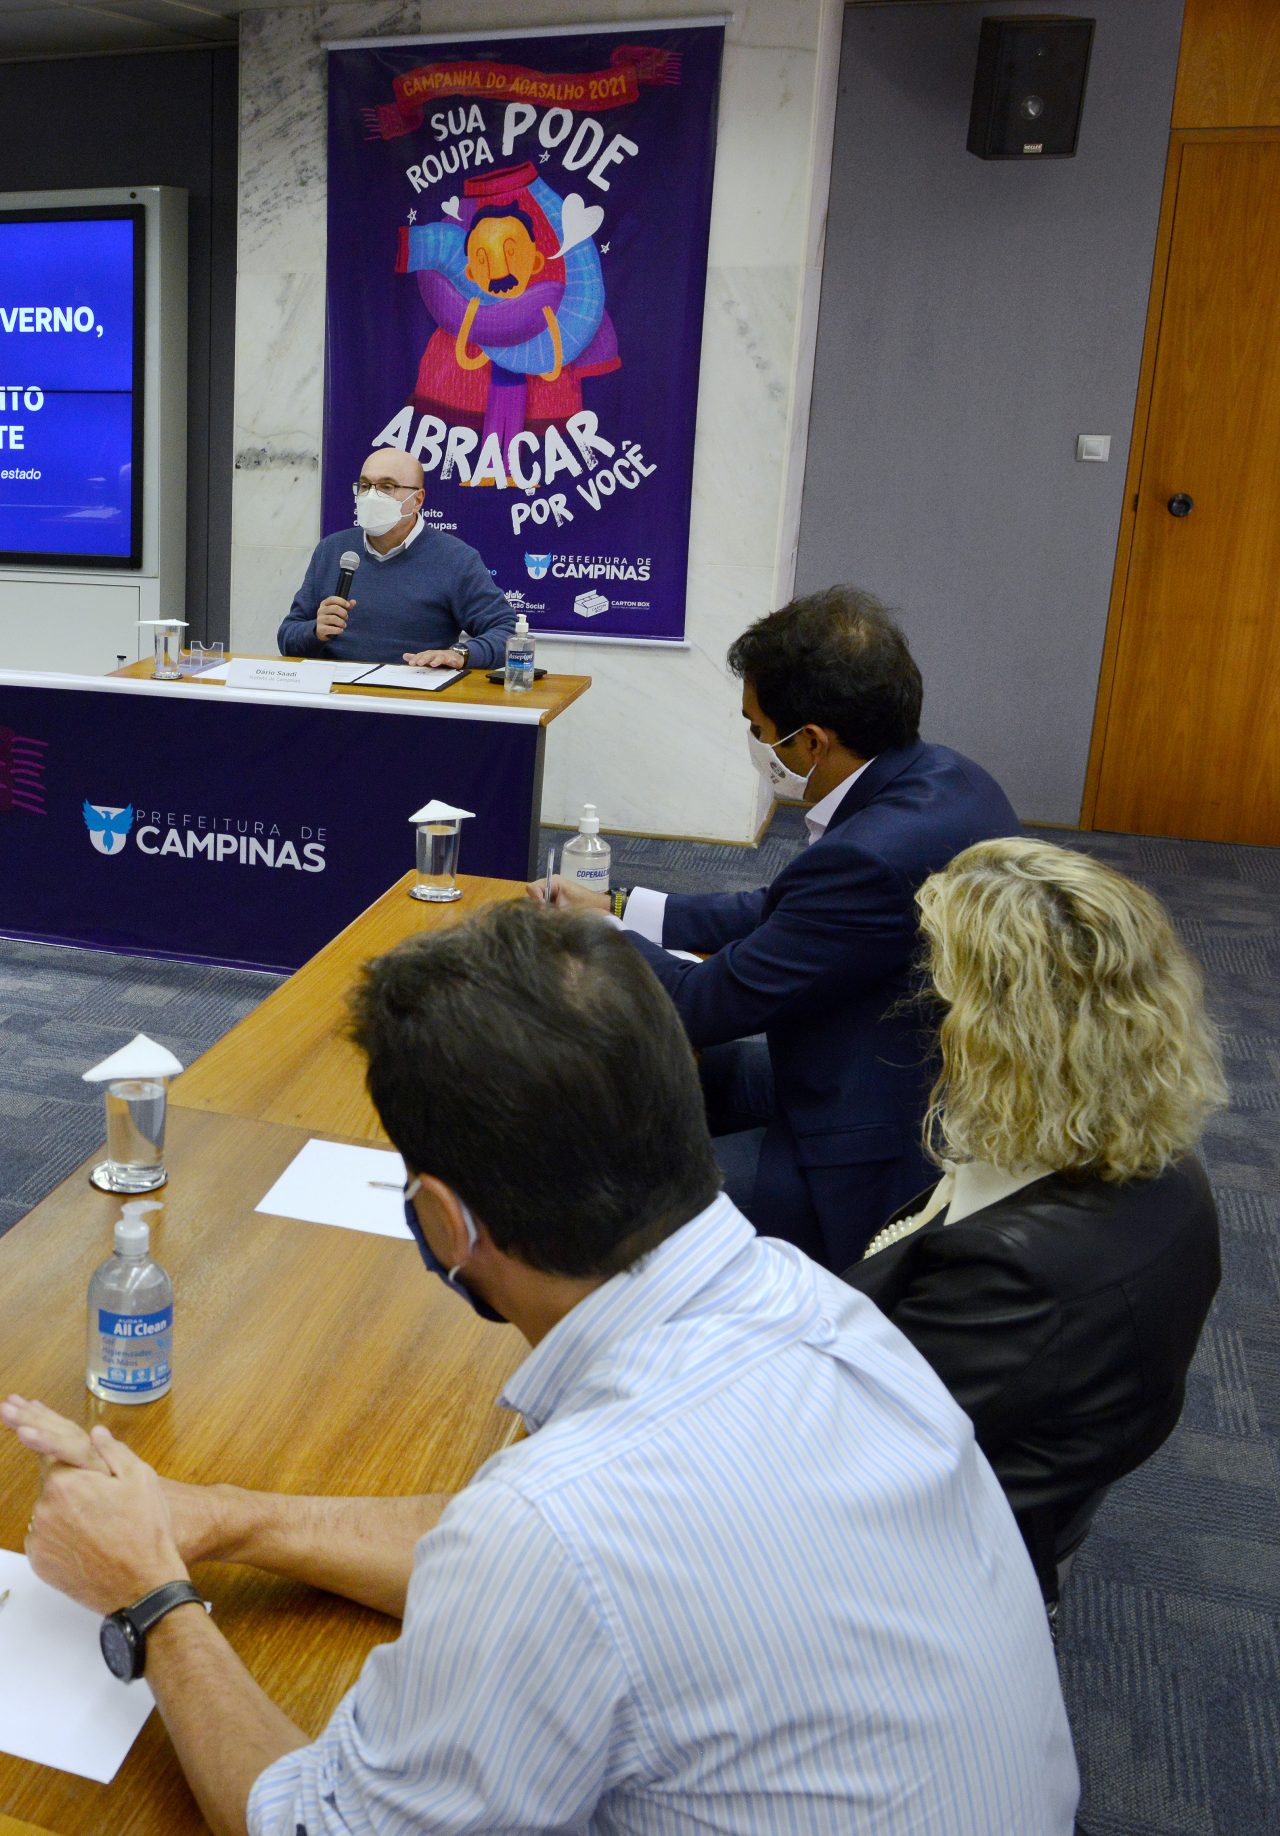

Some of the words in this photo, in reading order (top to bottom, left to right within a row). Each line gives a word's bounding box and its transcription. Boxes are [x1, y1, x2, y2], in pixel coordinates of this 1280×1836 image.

[402, 70, 482, 97] CAMPANHA
[486, 72, 507, 89] DO
[509, 75, 585, 100] AGASALHO
[588, 74, 628, 100] 2021
[430, 103, 486, 142] SUA
[502, 102, 639, 192] PODE
[405, 136, 494, 193] ROUPA
[371, 405, 616, 496] ABRAÇAR
[1, 468, 42, 480] estado
[510, 493, 574, 535] POR
[577, 440, 658, 511] VOCÊ
[421, 508, 444, 519] jeito
[552, 555, 628, 565] PREFEITURA
[637, 558, 651, 566] DE
[552, 563, 651, 582] CAMPINAS
[525, 602, 545, 610] Social
[255, 668, 275, 676] Dário
[136, 809, 281, 837] PREFEITURA
[300, 826, 327, 842] DE
[135, 825, 327, 873] CAMPINAS
[113, 1323, 132, 1336] All
[134, 1320, 167, 1336] Clean
